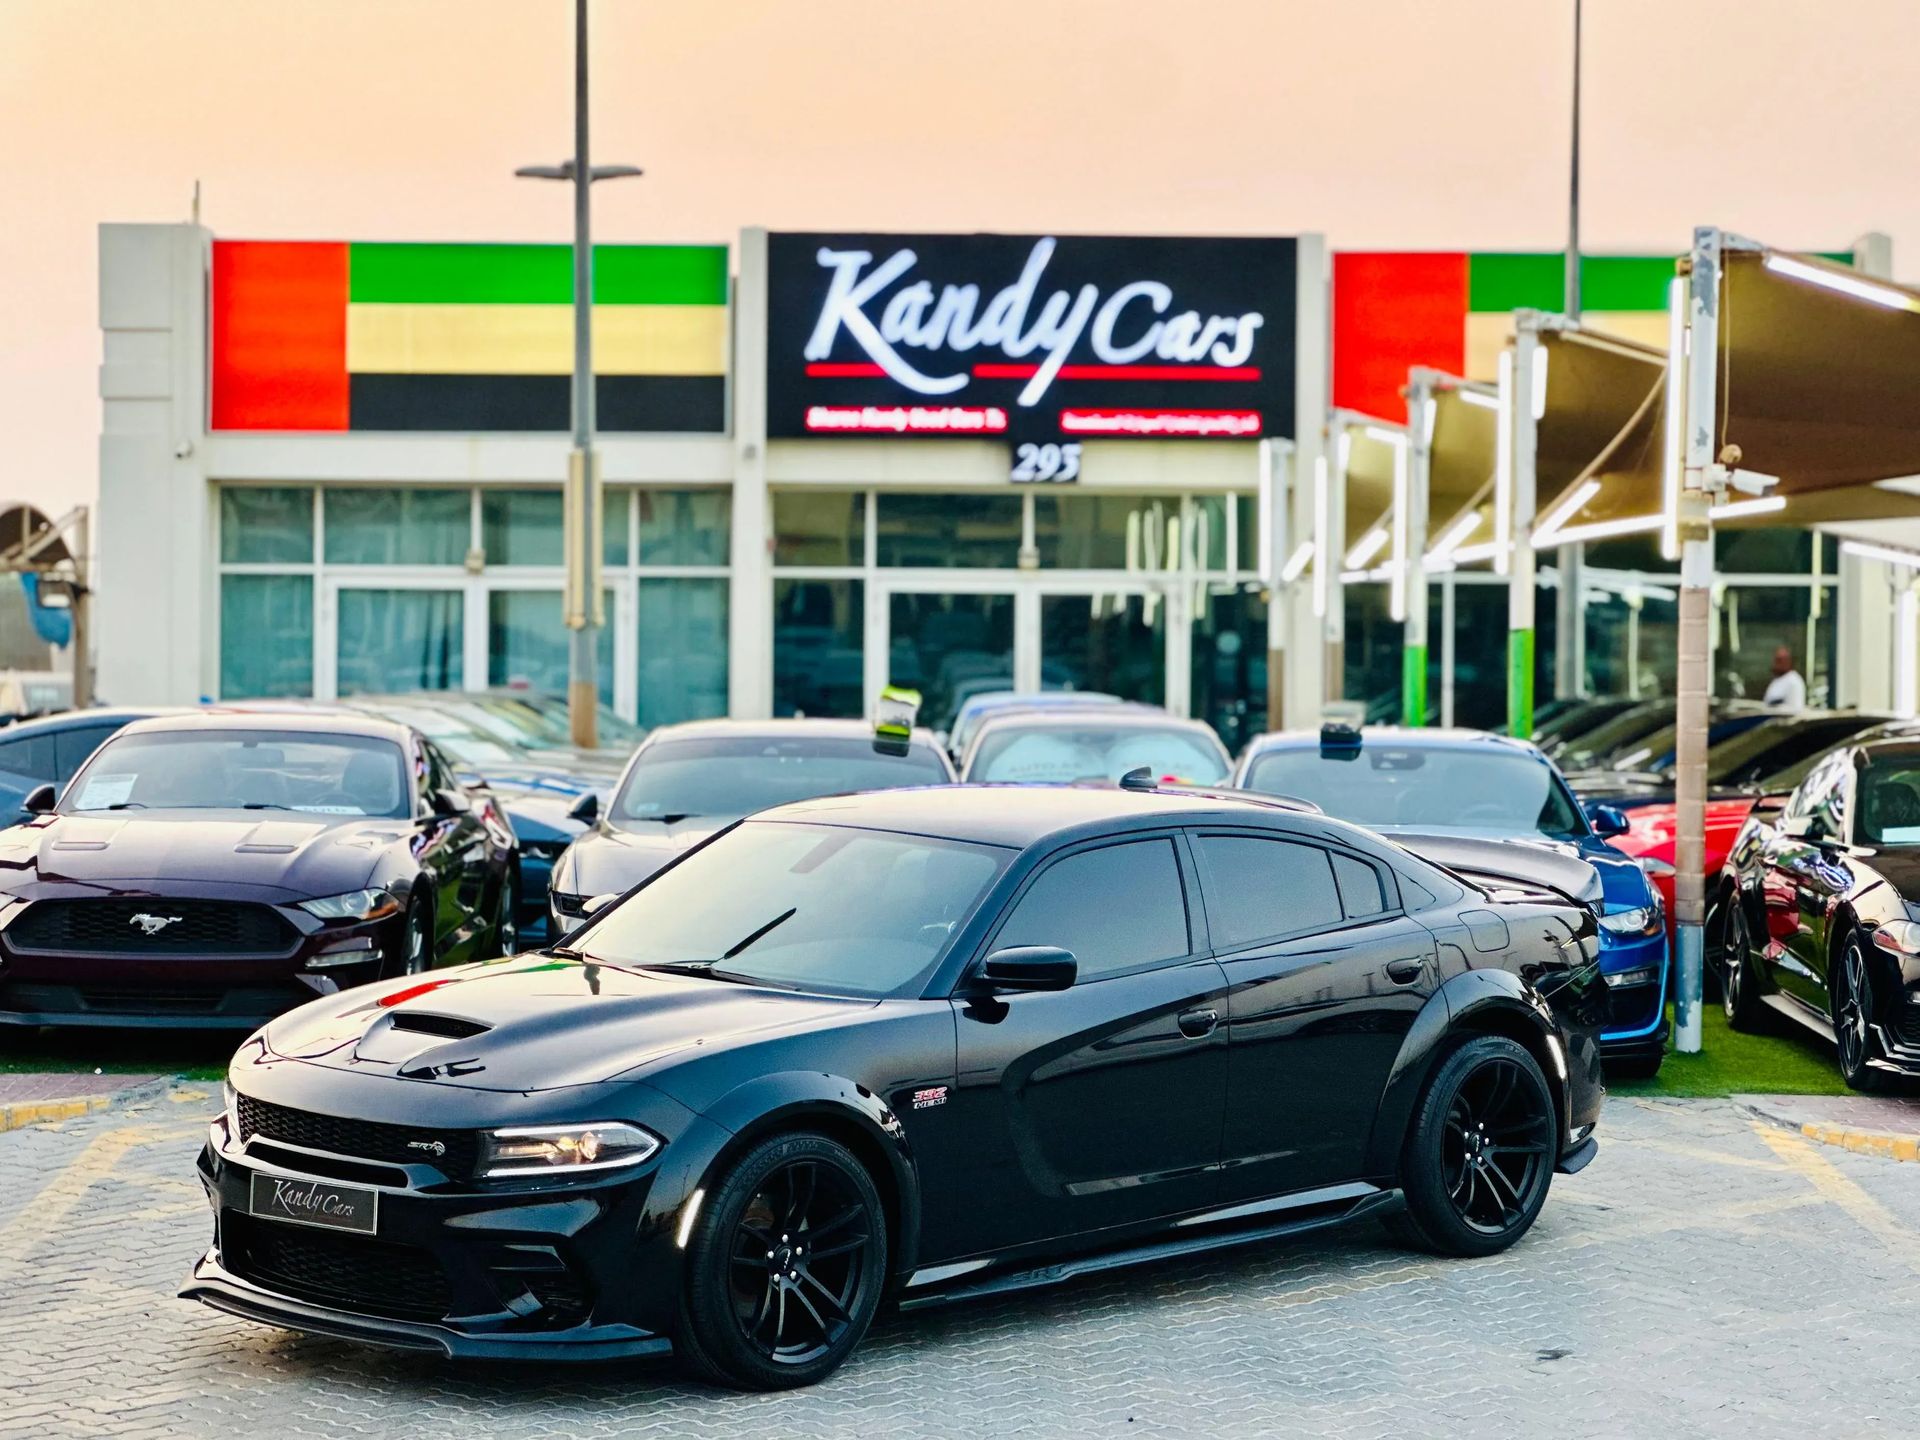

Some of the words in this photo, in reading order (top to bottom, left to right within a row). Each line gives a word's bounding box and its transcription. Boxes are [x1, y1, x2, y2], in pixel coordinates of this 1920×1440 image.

[804, 236, 1099, 407] Kandy
[1091, 280, 1264, 368] Cars
[1010, 442, 1082, 482] 295
[272, 1180, 322, 1219] Kandy
[322, 1195, 355, 1216] Cars
